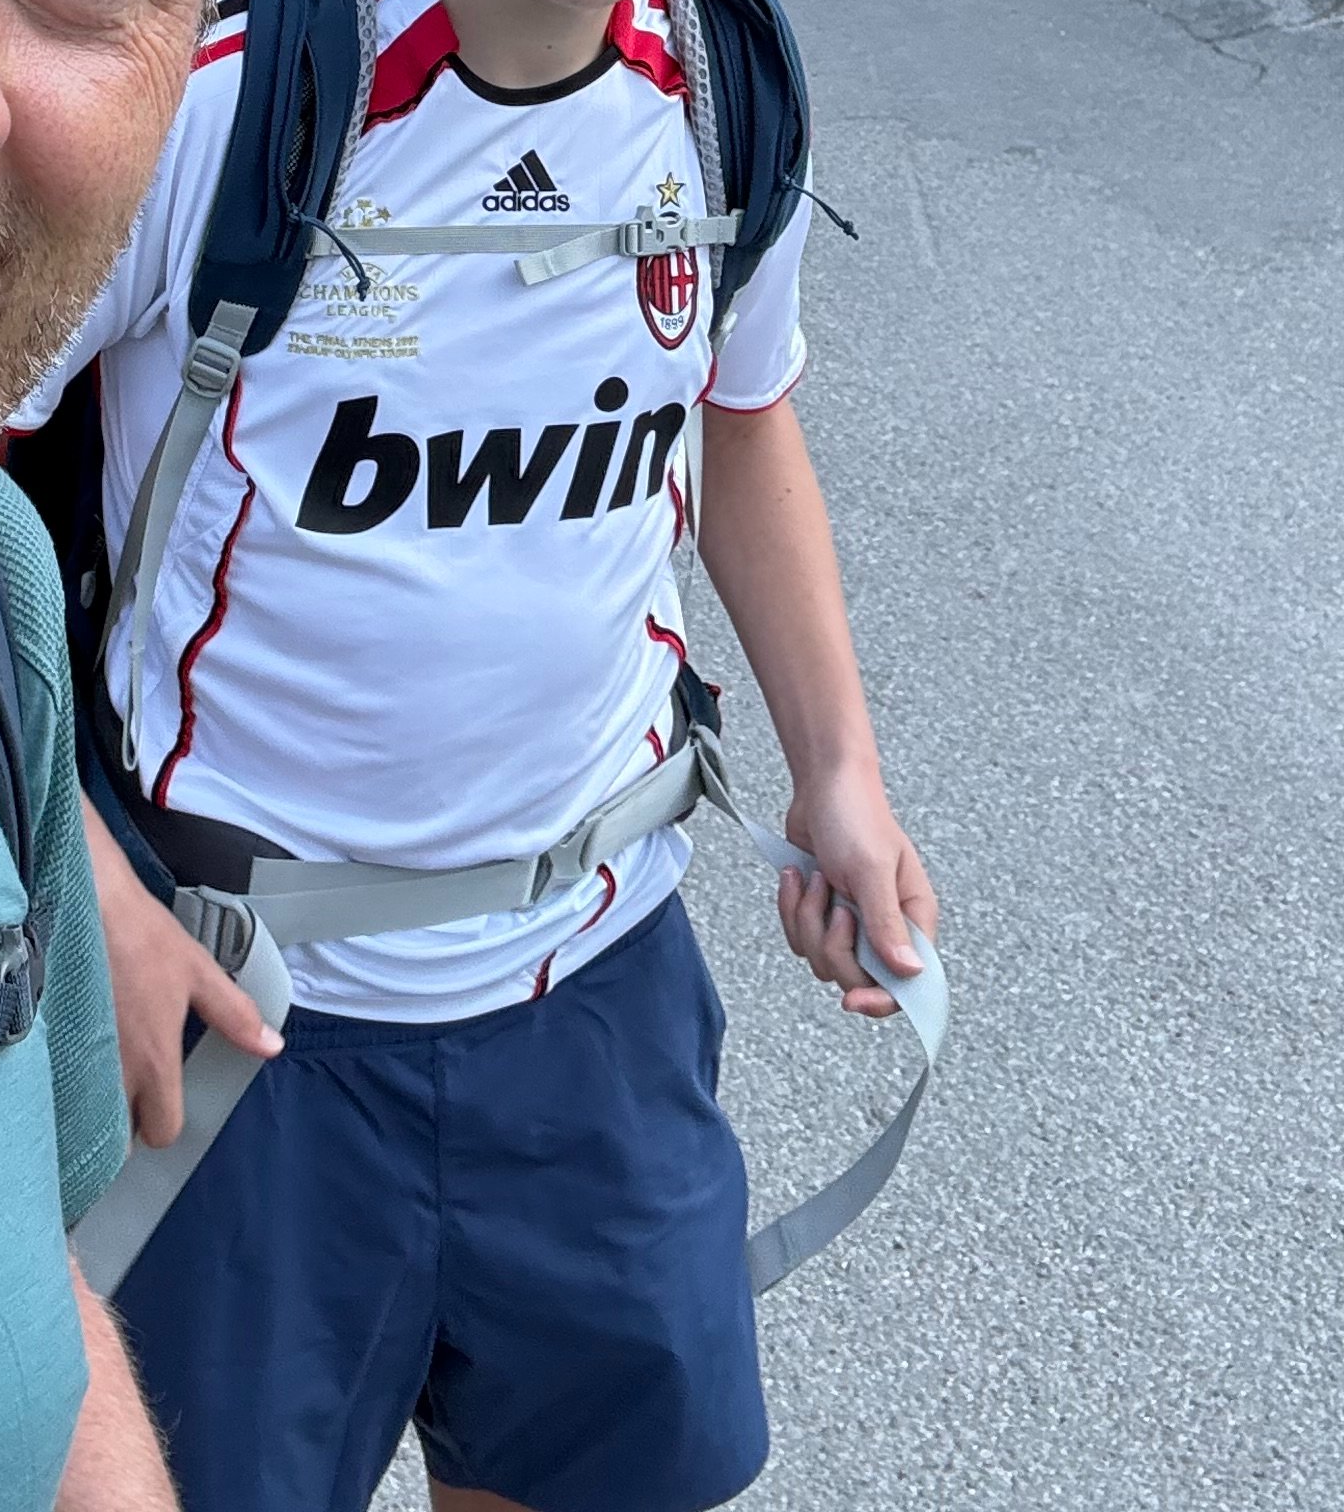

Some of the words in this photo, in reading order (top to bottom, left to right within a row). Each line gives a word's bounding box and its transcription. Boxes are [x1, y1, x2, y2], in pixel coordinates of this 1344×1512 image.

[481, 190, 571, 212] adidas
[300, 284, 420, 302] CHAMIONS
[326, 303, 392, 318] LEAGUE
[659, 315, 685, 331] 1899
[294, 376, 687, 536] bwin
